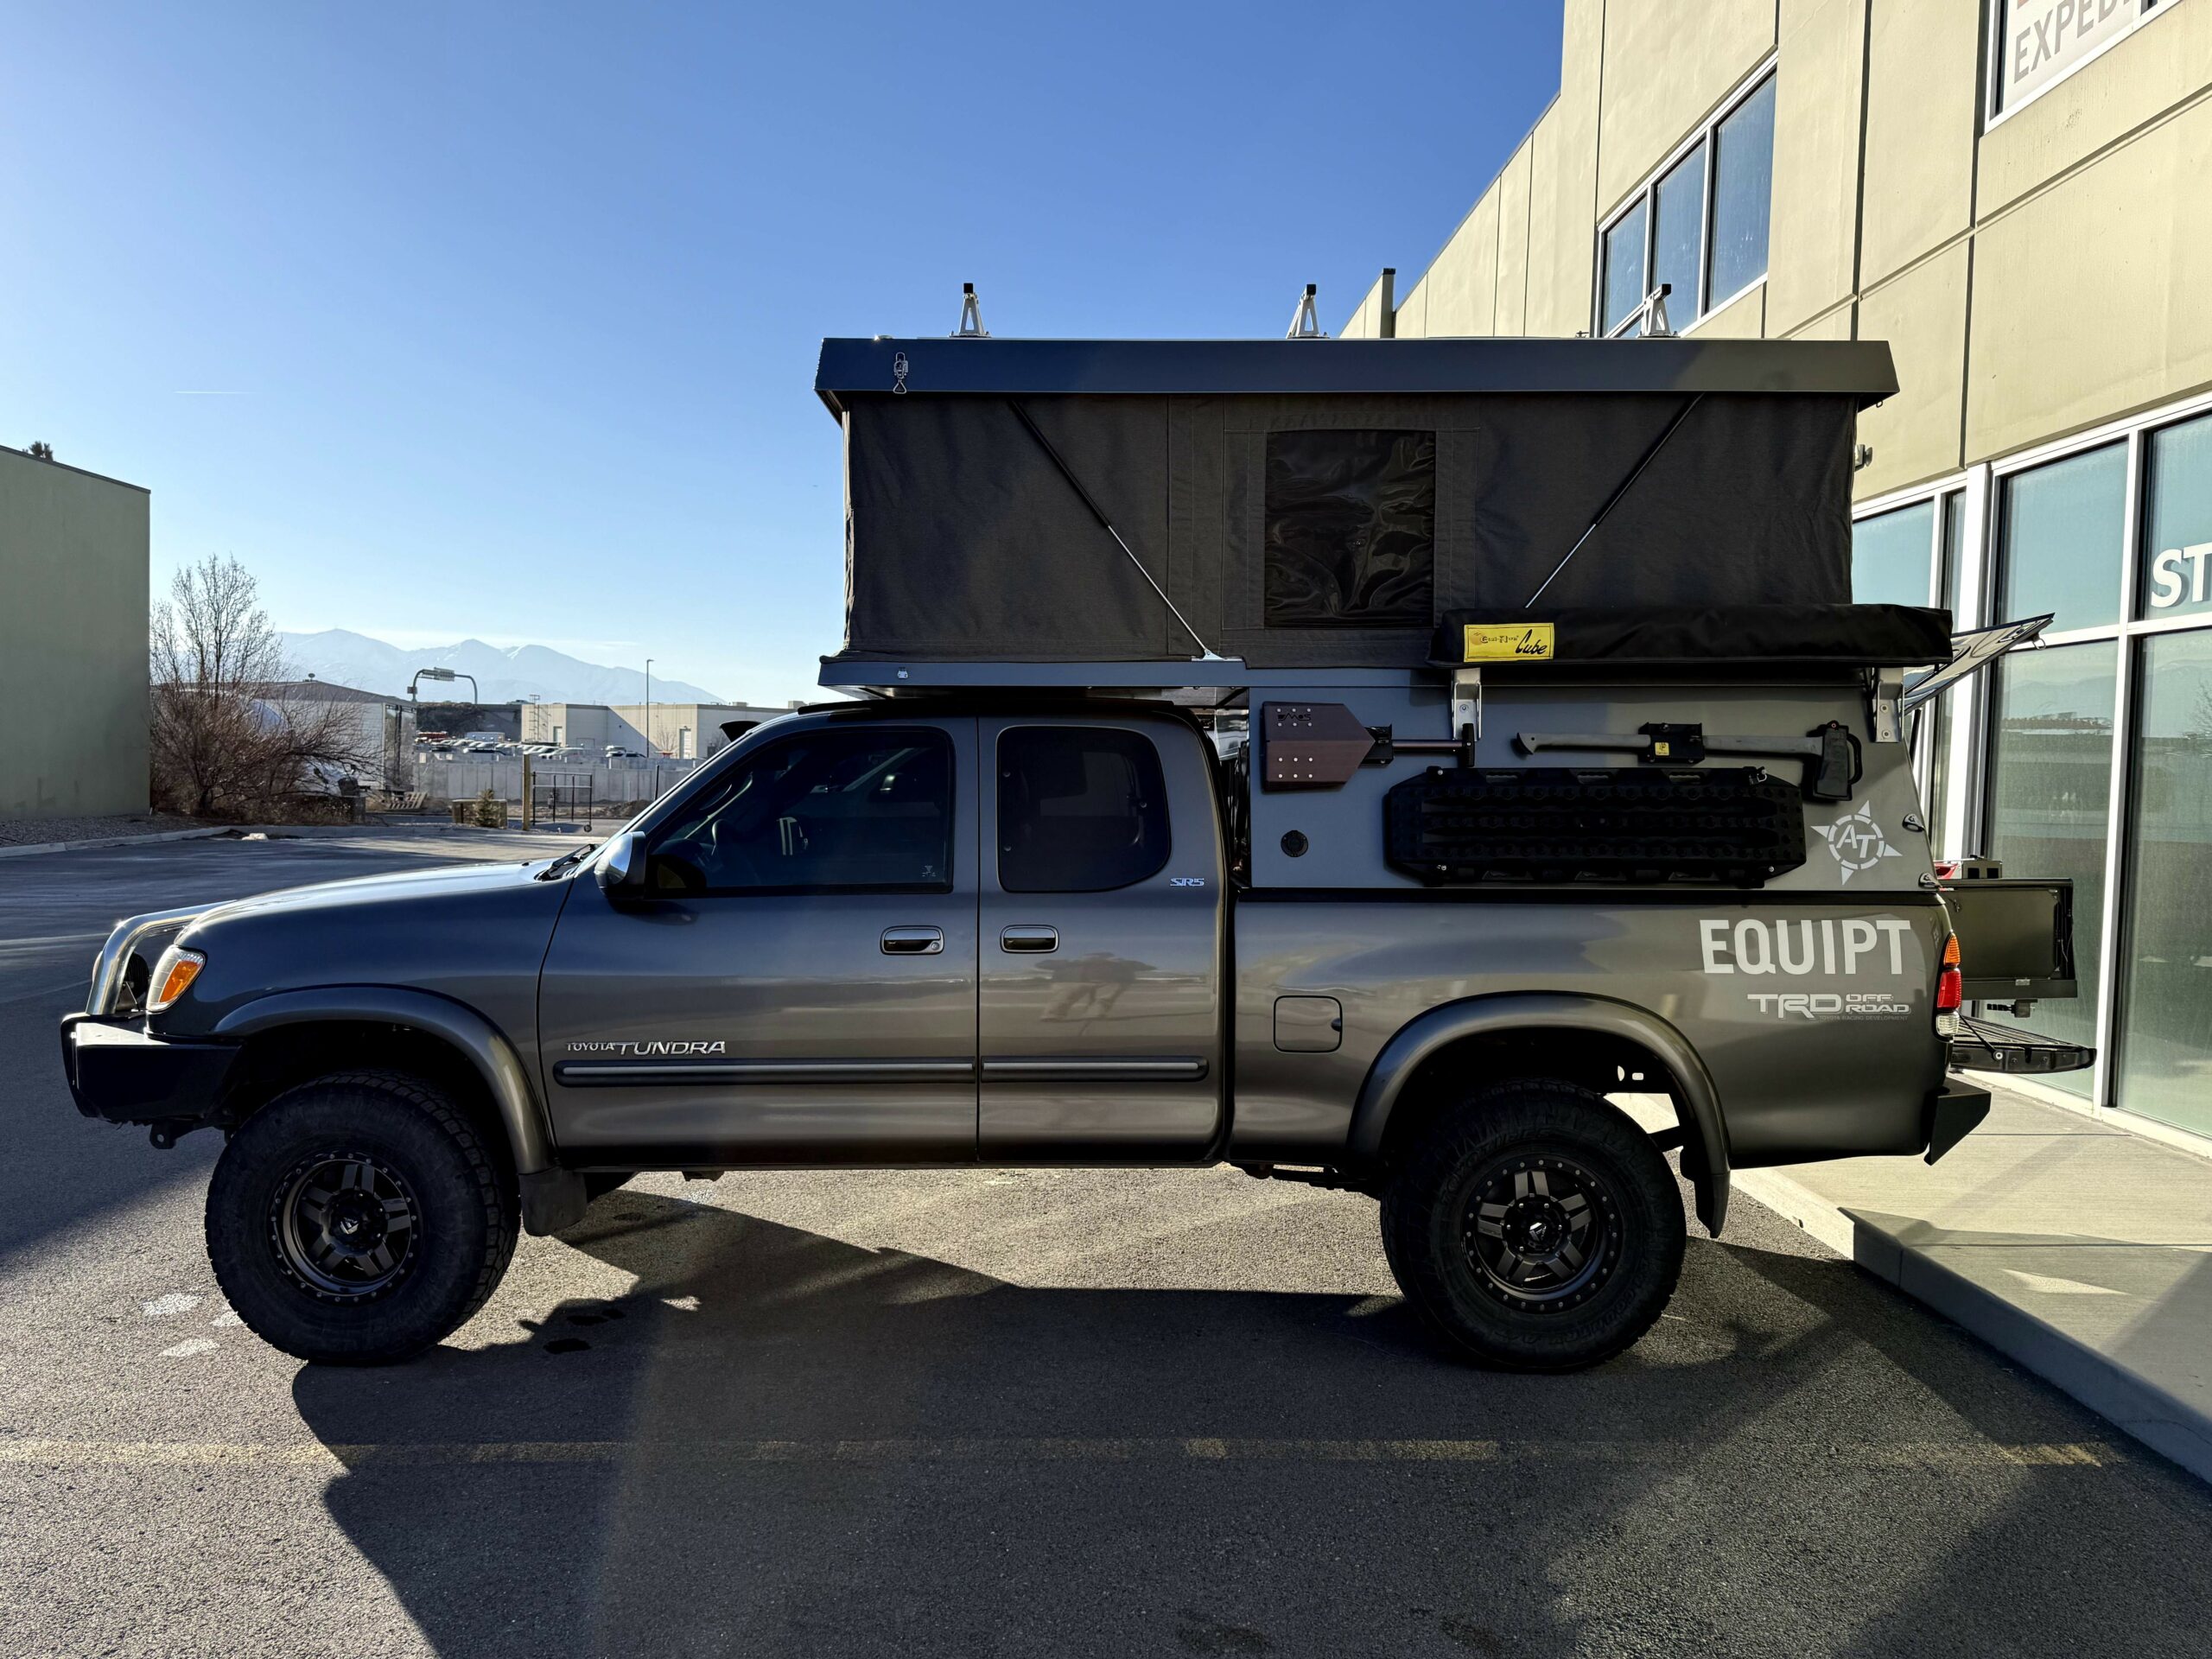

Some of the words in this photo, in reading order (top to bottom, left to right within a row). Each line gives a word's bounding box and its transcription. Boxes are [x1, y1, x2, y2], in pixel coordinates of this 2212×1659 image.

[2014, 0, 2129, 84] EXPED
[1836, 824, 1877, 859] AT
[1169, 877, 1205, 887] SR5
[1700, 919, 1910, 975] EQUIPT
[1747, 994, 1844, 1019] TRD
[1845, 994, 1894, 1003] OFF
[1845, 1004, 1911, 1014] ROAD
[566, 1041, 615, 1052] TOYOTA
[614, 1041, 726, 1056] TUNDRA
